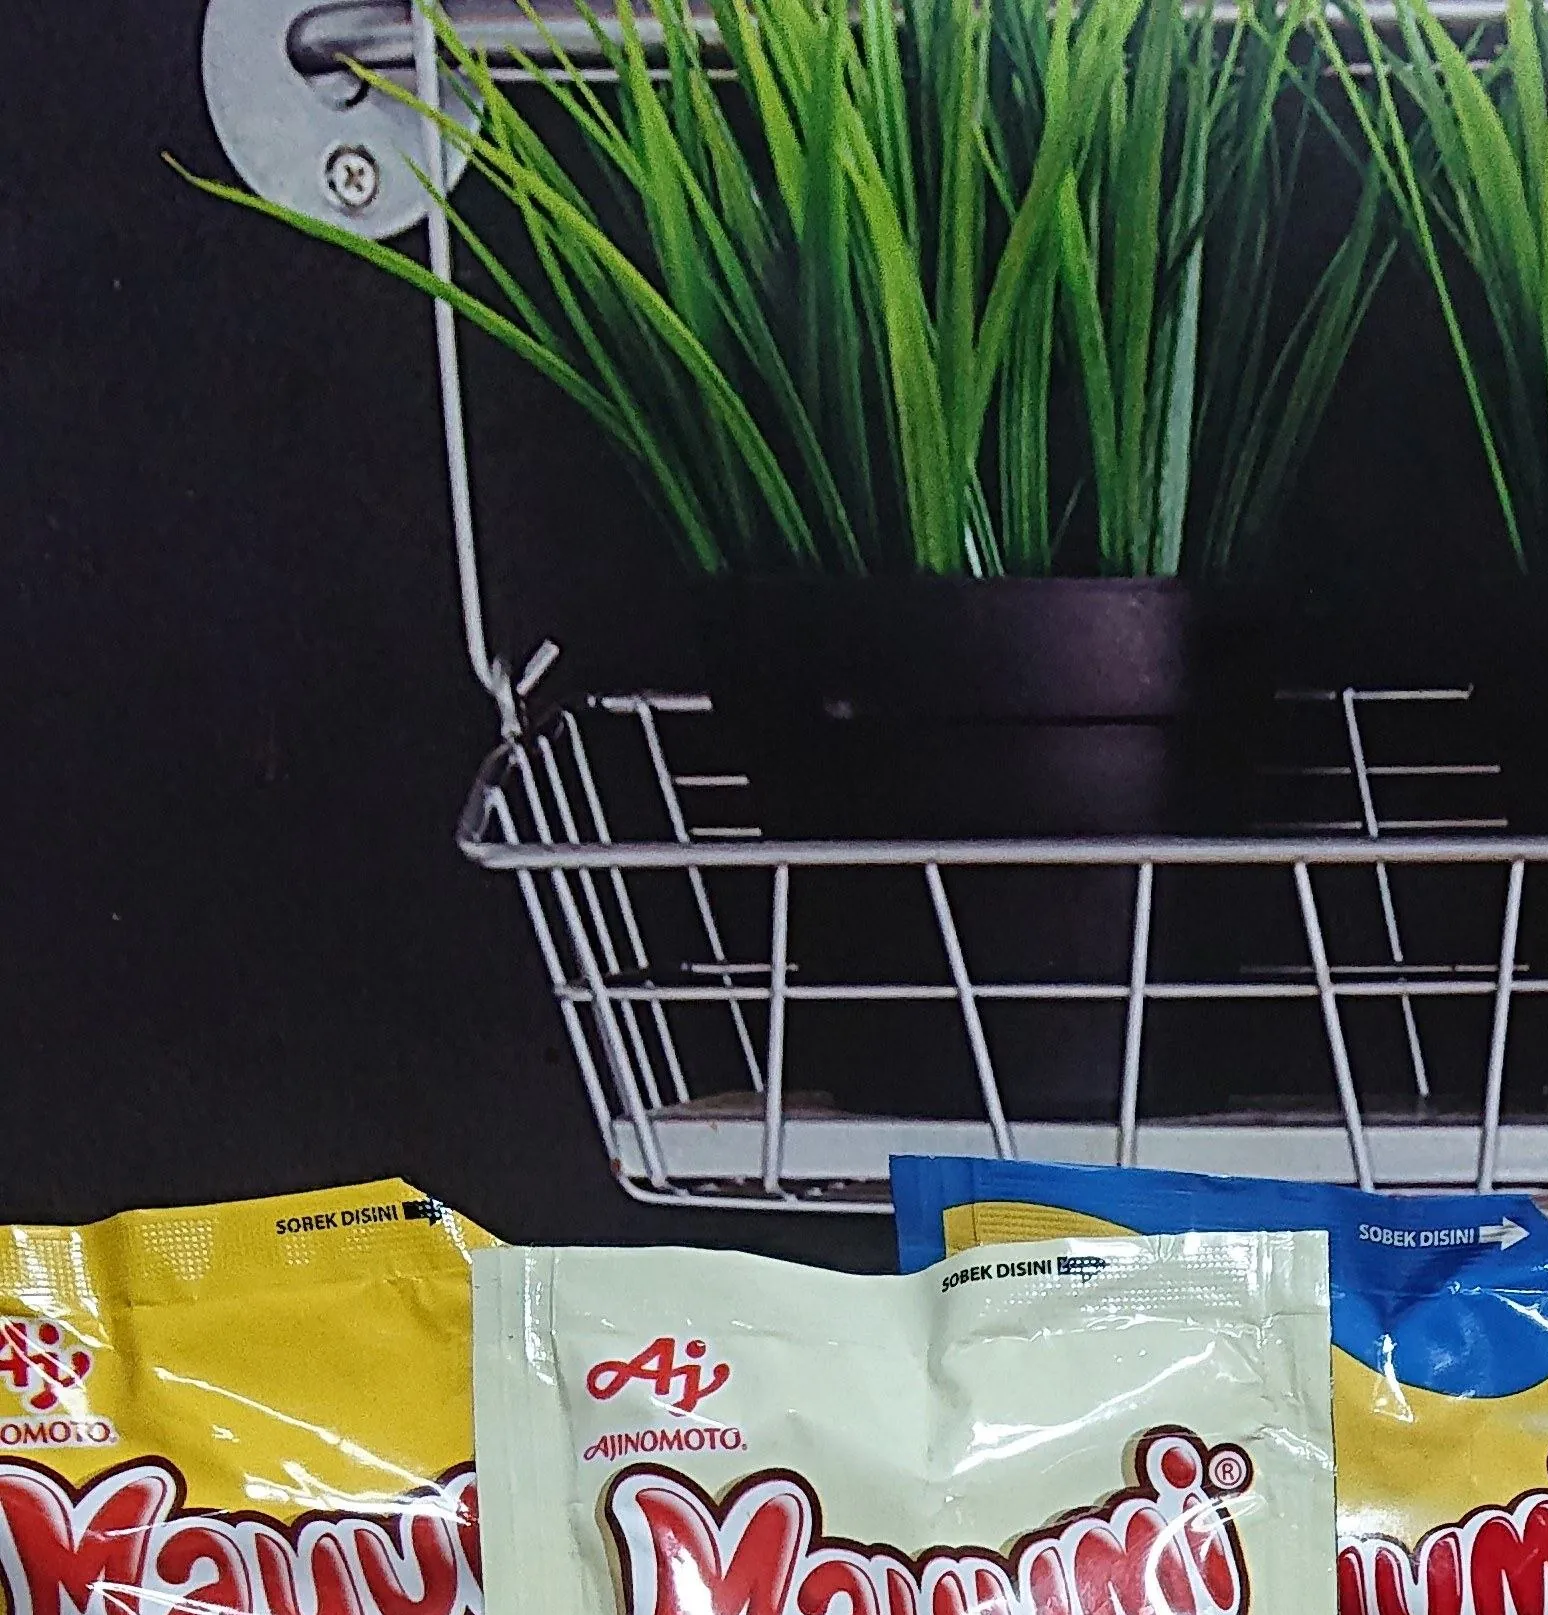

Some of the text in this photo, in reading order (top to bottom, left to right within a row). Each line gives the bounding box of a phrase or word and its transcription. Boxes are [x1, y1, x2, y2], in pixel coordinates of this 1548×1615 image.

[341, 1204, 399, 1226] DISINI
[1359, 1224, 1475, 1248] SOBEK DISINI
[941, 1259, 1052, 1293] SOBEK DISINI
